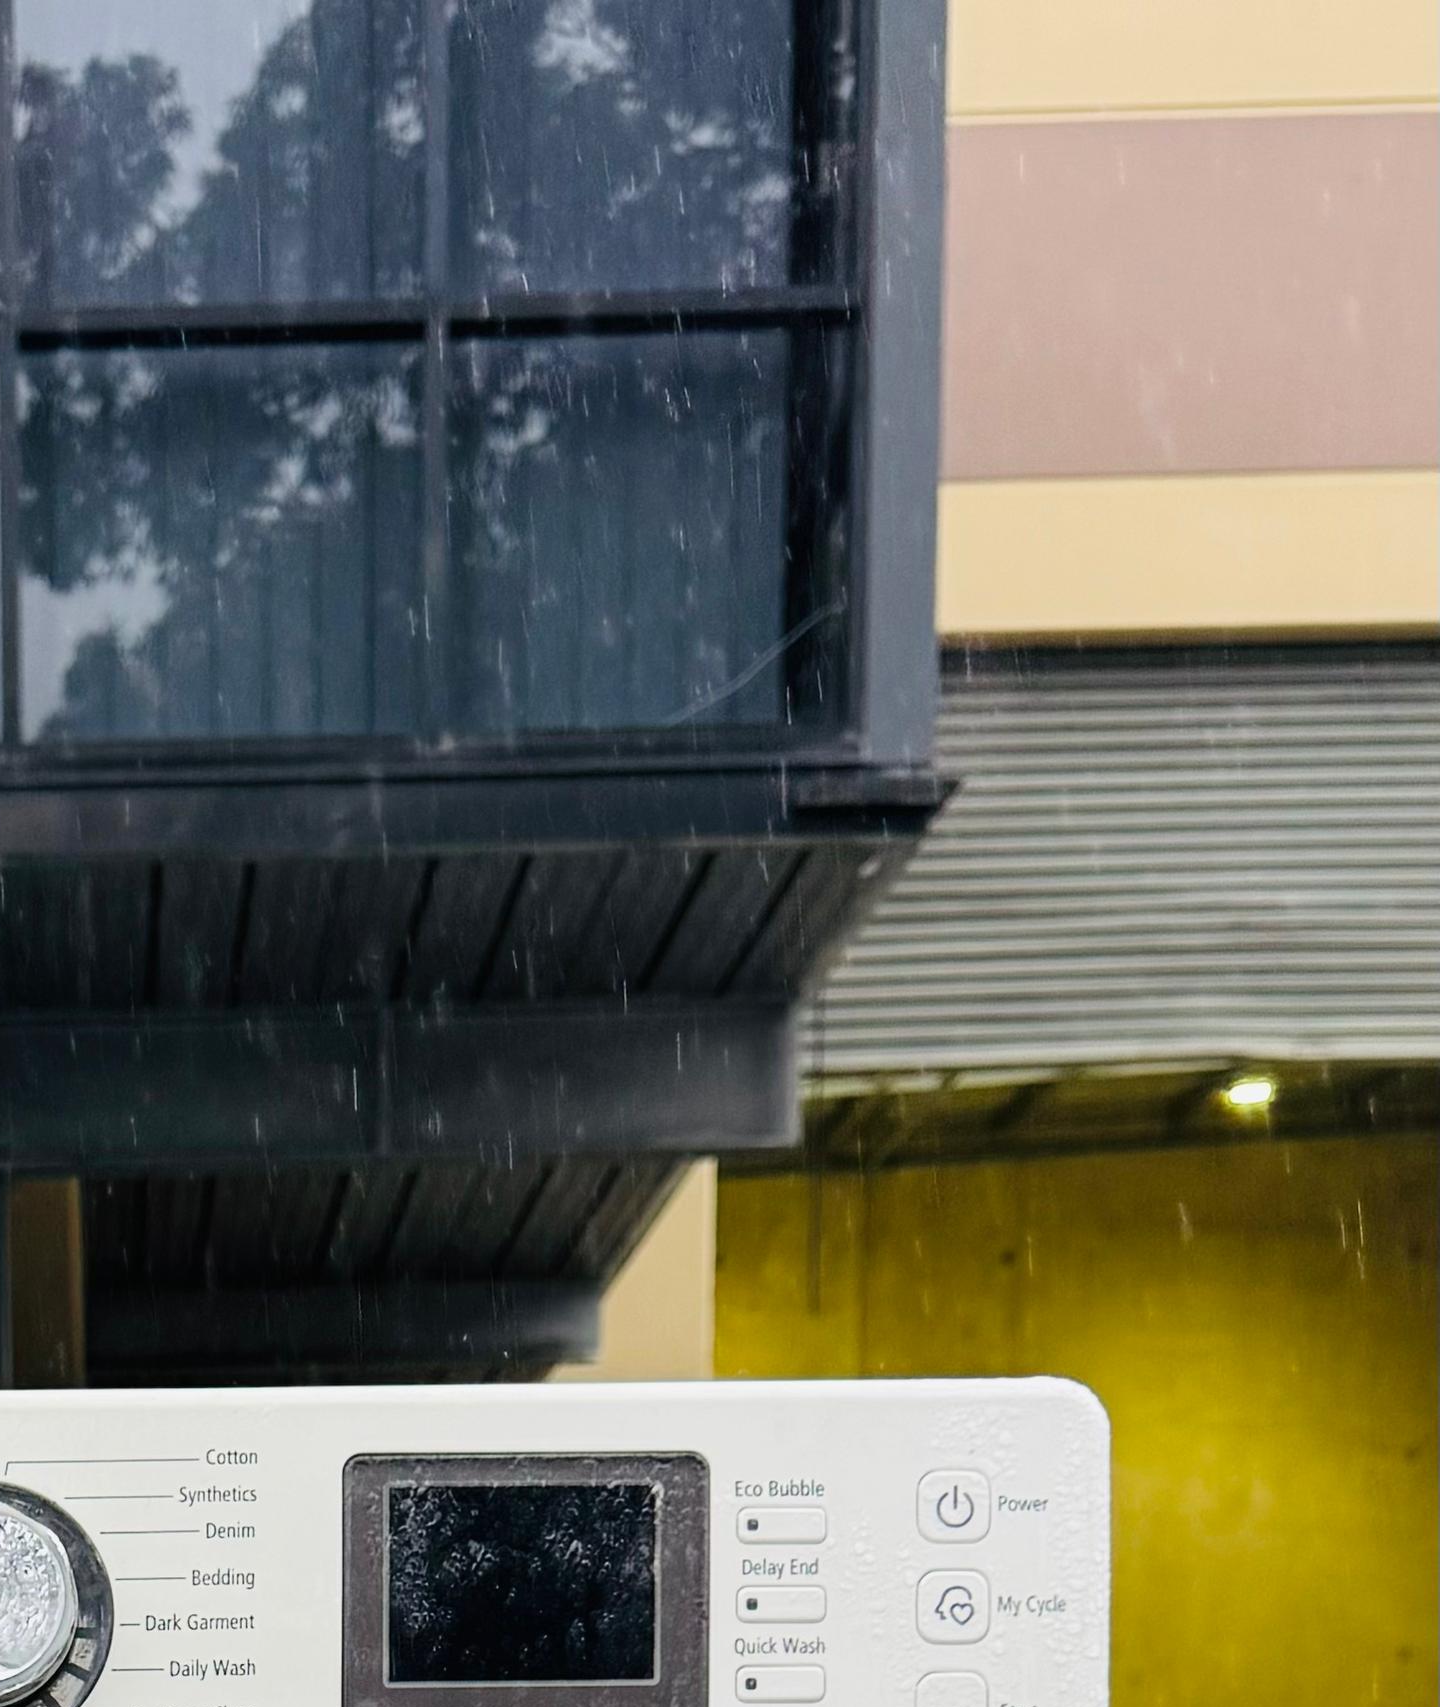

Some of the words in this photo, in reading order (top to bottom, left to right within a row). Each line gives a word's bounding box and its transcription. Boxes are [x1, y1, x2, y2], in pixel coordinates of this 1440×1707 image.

[206, 1449, 258, 1465] Cotton
[179, 1485, 257, 1507] Synthetics
[734, 1480, 763, 1497] Eco
[768, 1479, 825, 1497] Bubble
[997, 1495, 1048, 1512] Power
[206, 1521, 256, 1539] Denim
[741, 1558, 784, 1579] Delay
[790, 1558, 819, 1575] End
[192, 1568, 255, 1590] Bedding
[997, 1596, 1022, 1617] My
[1026, 1595, 1066, 1617] Cycle
[145, 1613, 181, 1631] Dark
[187, 1613, 255, 1630] Garment
[734, 1637, 777, 1655] Quick
[782, 1637, 826, 1654] Wash
[170, 1658, 208, 1681] Daily
[213, 1658, 256, 1676] Wash
